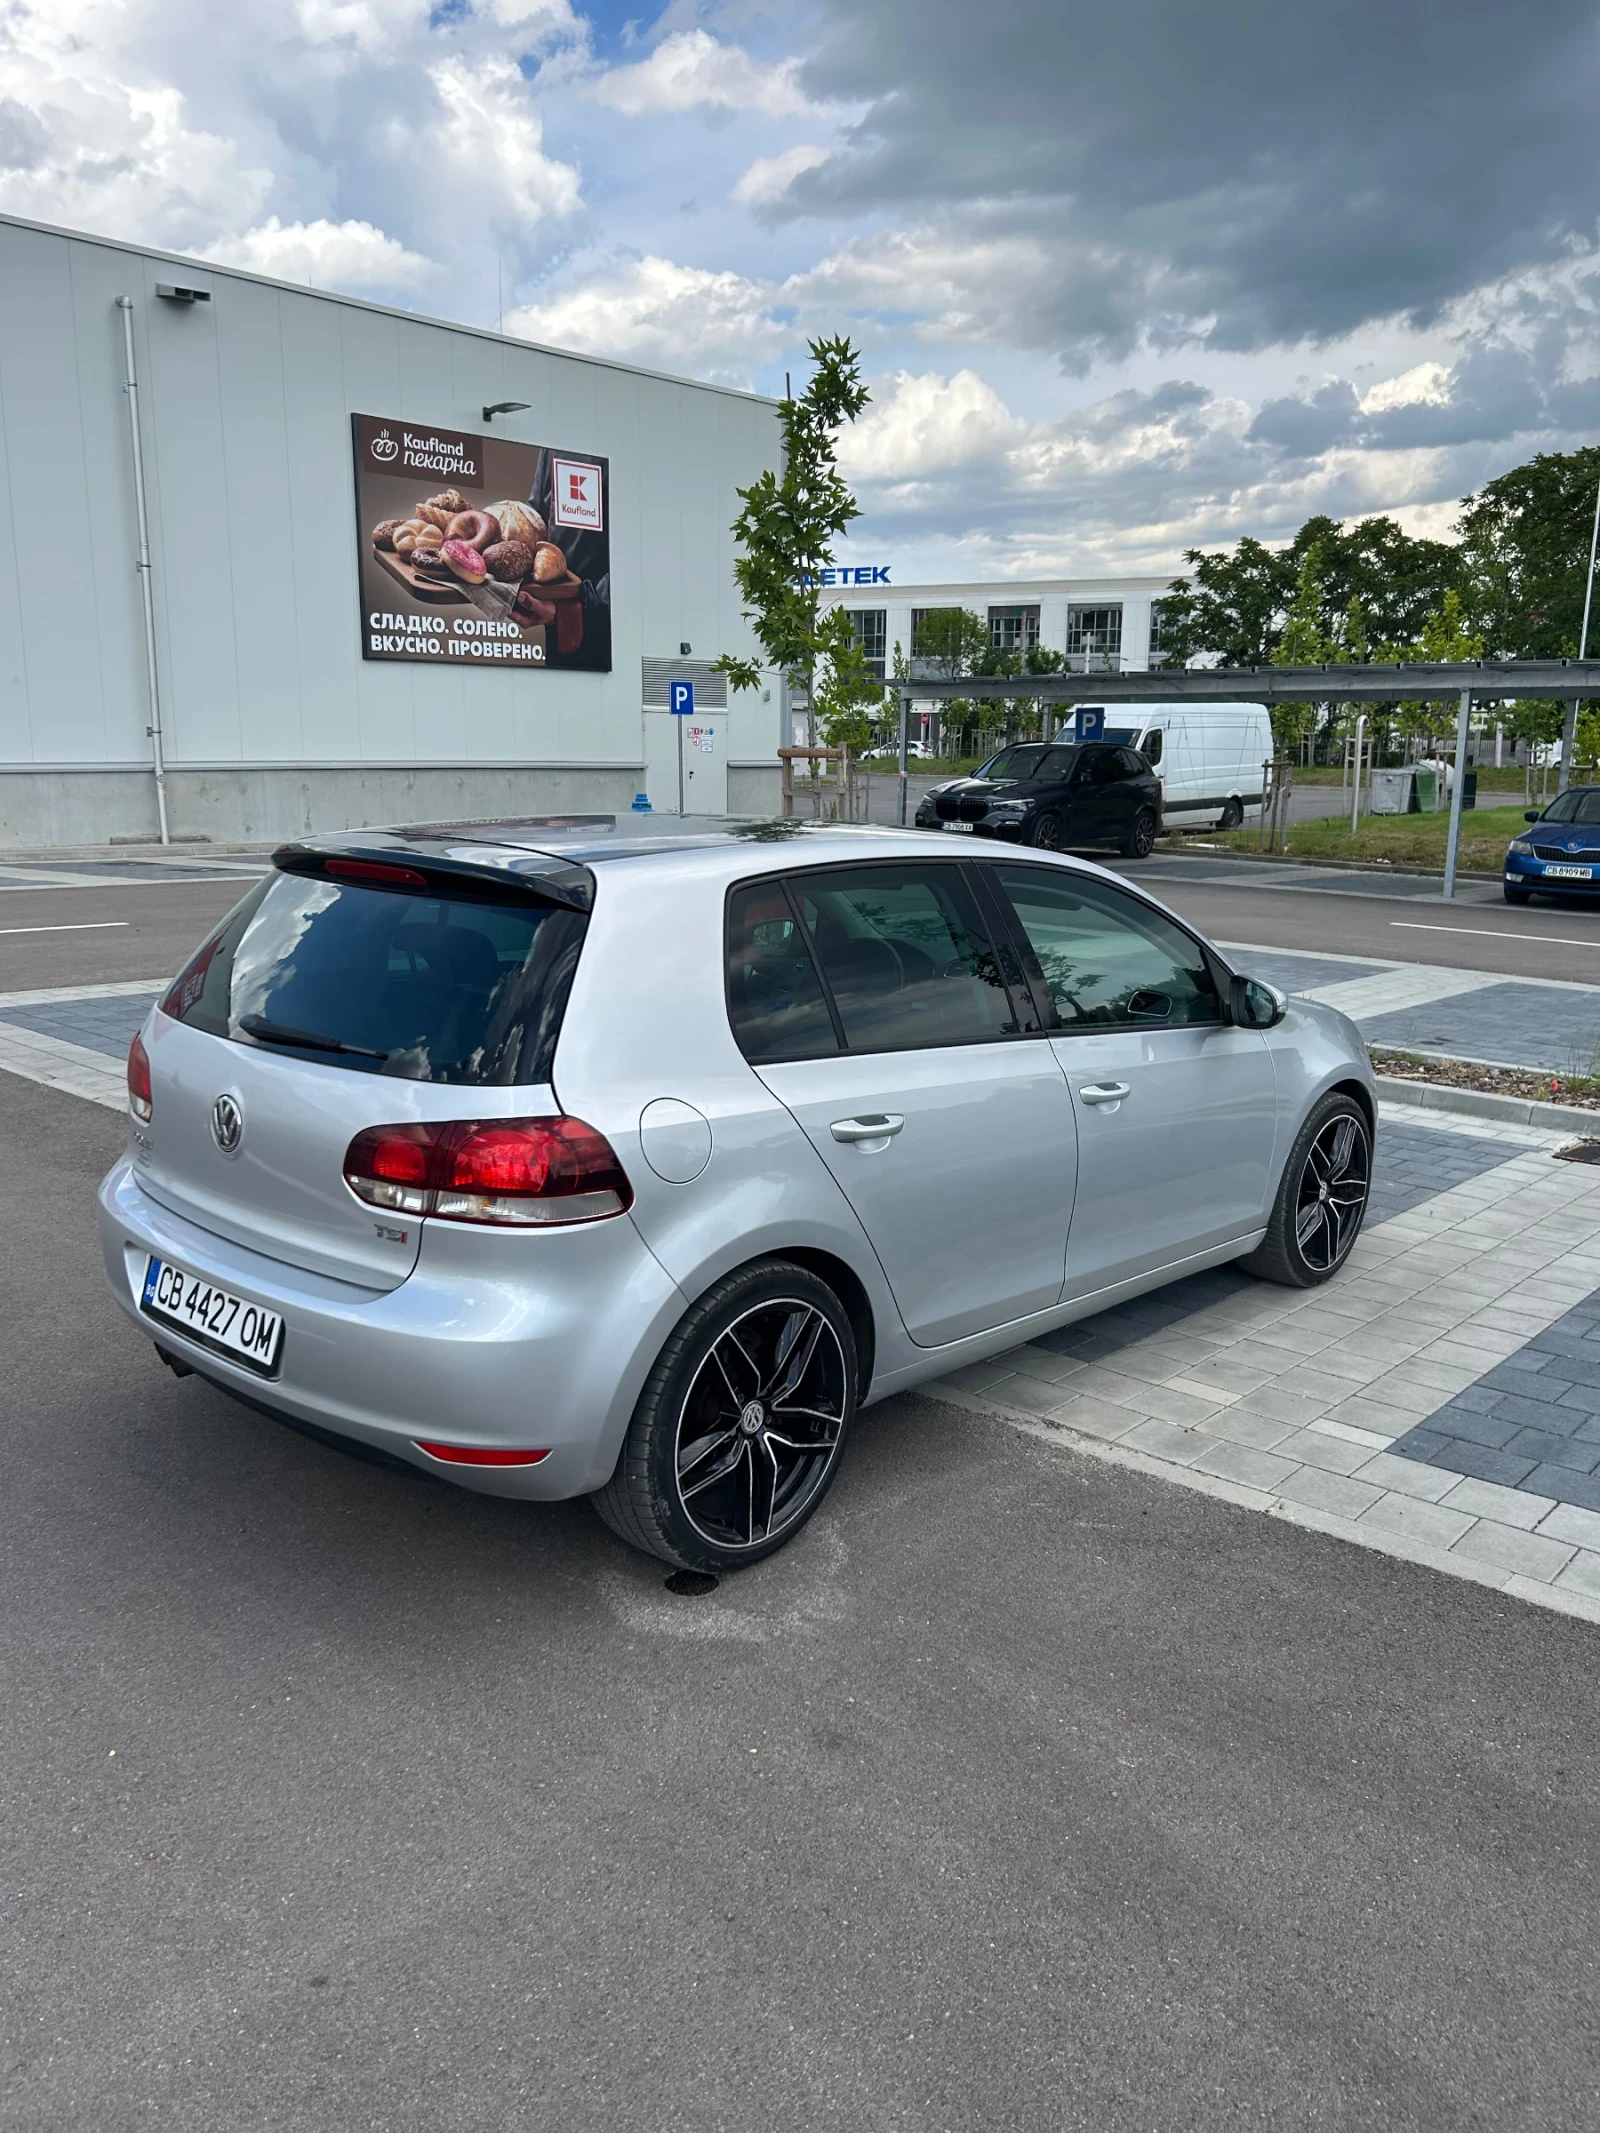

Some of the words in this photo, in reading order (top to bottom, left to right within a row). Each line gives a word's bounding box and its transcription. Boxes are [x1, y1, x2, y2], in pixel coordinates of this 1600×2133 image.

[403, 432, 464, 456] Kaufland
[403, 450, 476, 475] пекарна
[561, 503, 597, 517] Kaufland
[793, 566, 892, 585] LETEK
[369, 612, 449, 635] СЛАДКО.
[453, 618, 523, 639] СОЛЕНО.
[370, 634, 444, 655] ВКУСНО.
[448, 639, 546, 661] ПРОВЕРЕНО.
[675, 686, 688, 710] P
[1082, 713, 1097, 736] P
[1547, 866, 1558, 875] CB
[1559, 867, 1579, 876] 8909
[1580, 869, 1591, 878] MB
[373, 1223, 408, 1244] TSI
[158, 1266, 184, 1311] CB
[185, 1282, 241, 1336] 4427
[240, 1307, 276, 1357] OM
